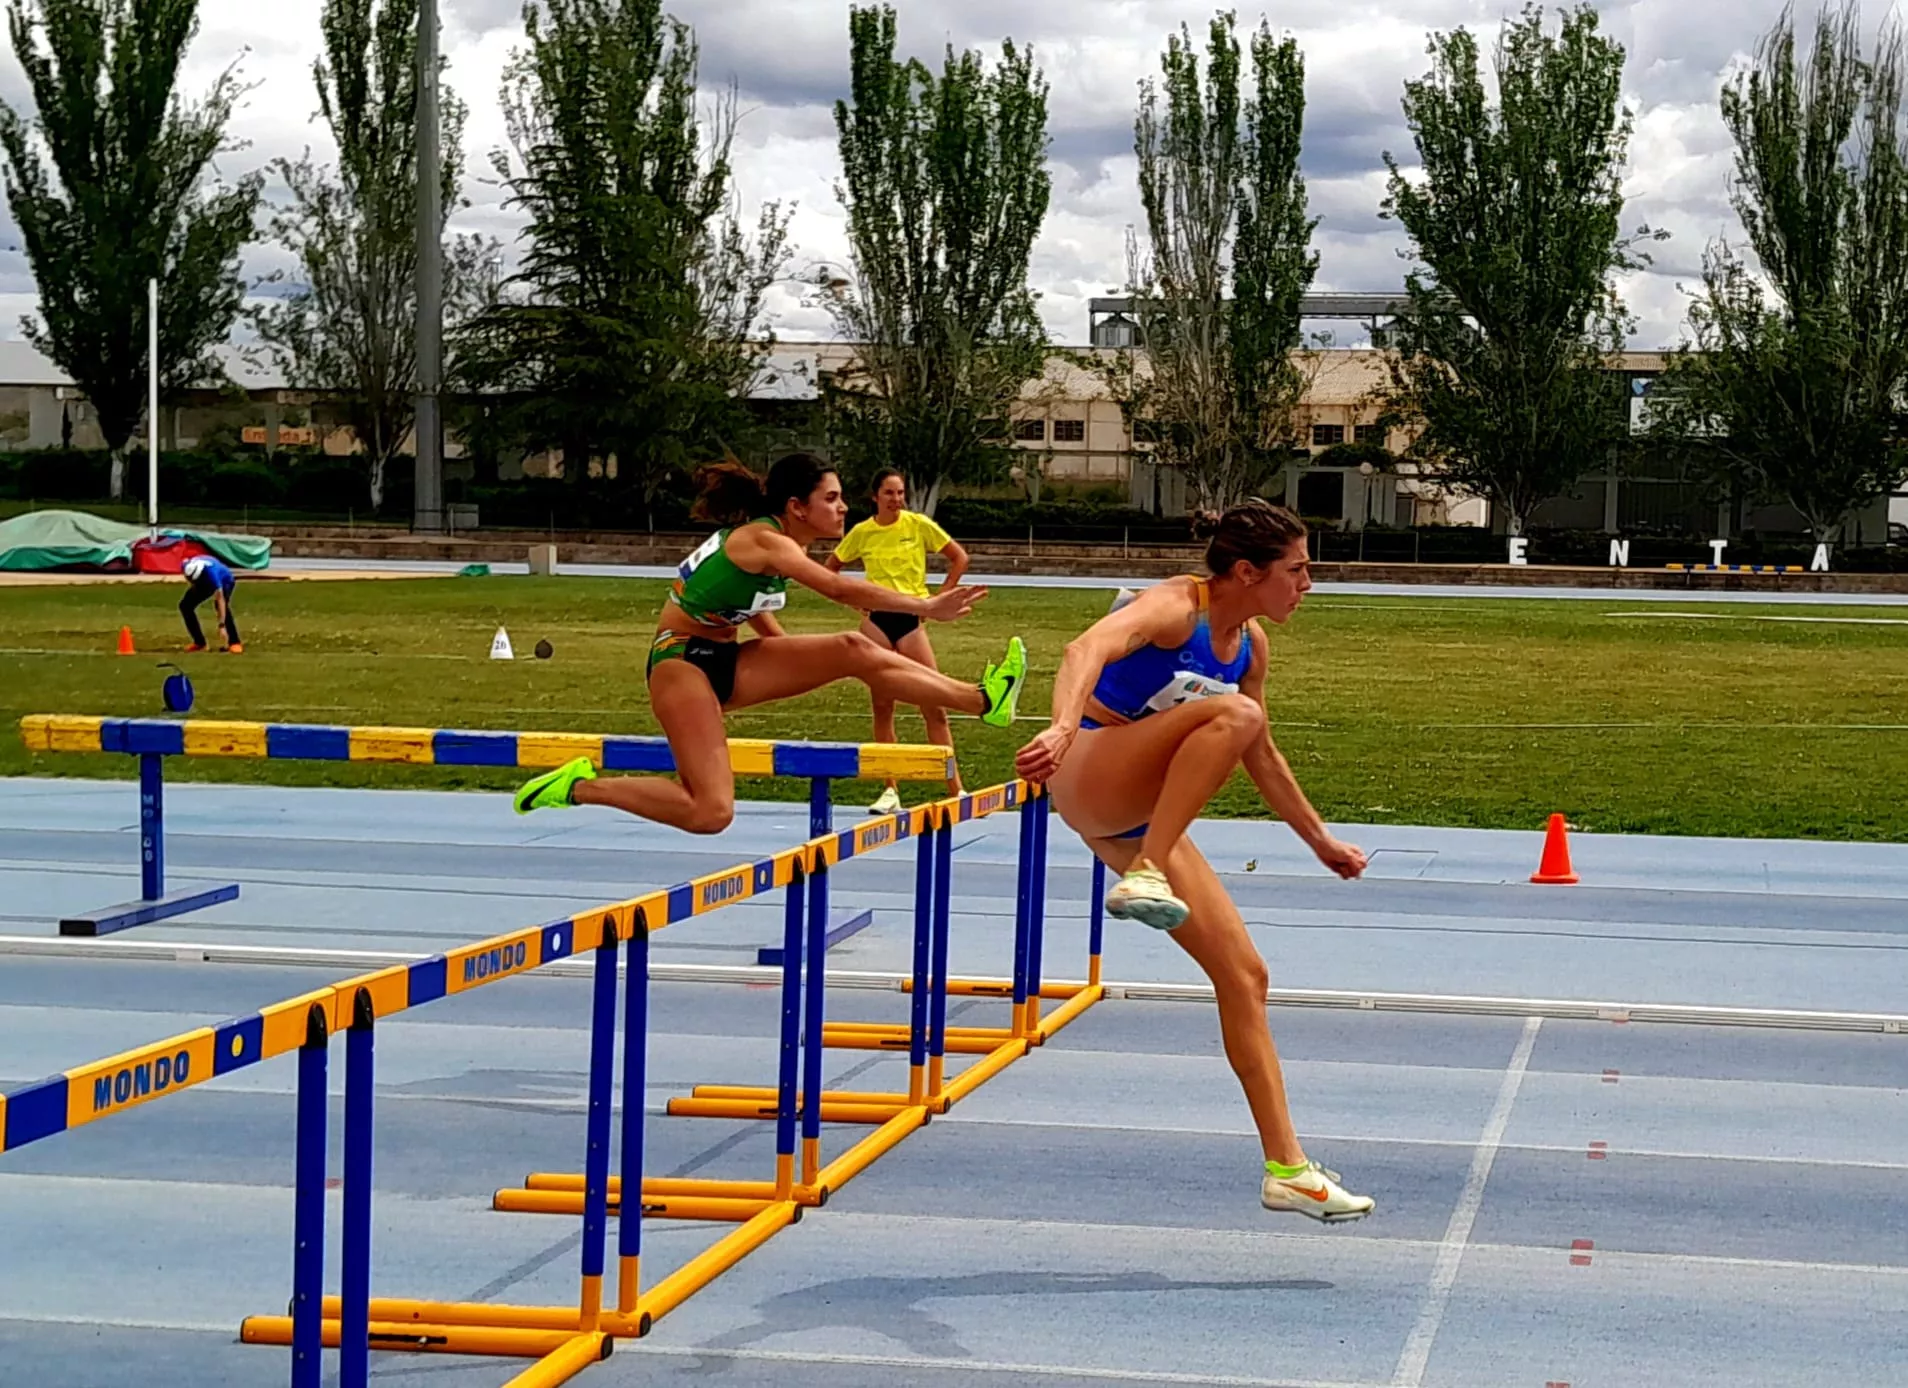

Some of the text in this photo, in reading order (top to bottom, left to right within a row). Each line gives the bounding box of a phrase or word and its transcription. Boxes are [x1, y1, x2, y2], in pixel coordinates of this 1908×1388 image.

[143, 794, 154, 862] MODO
[703, 873, 743, 906] MONDO
[464, 940, 526, 983] MONDO
[93, 1049, 190, 1113] MONDO
